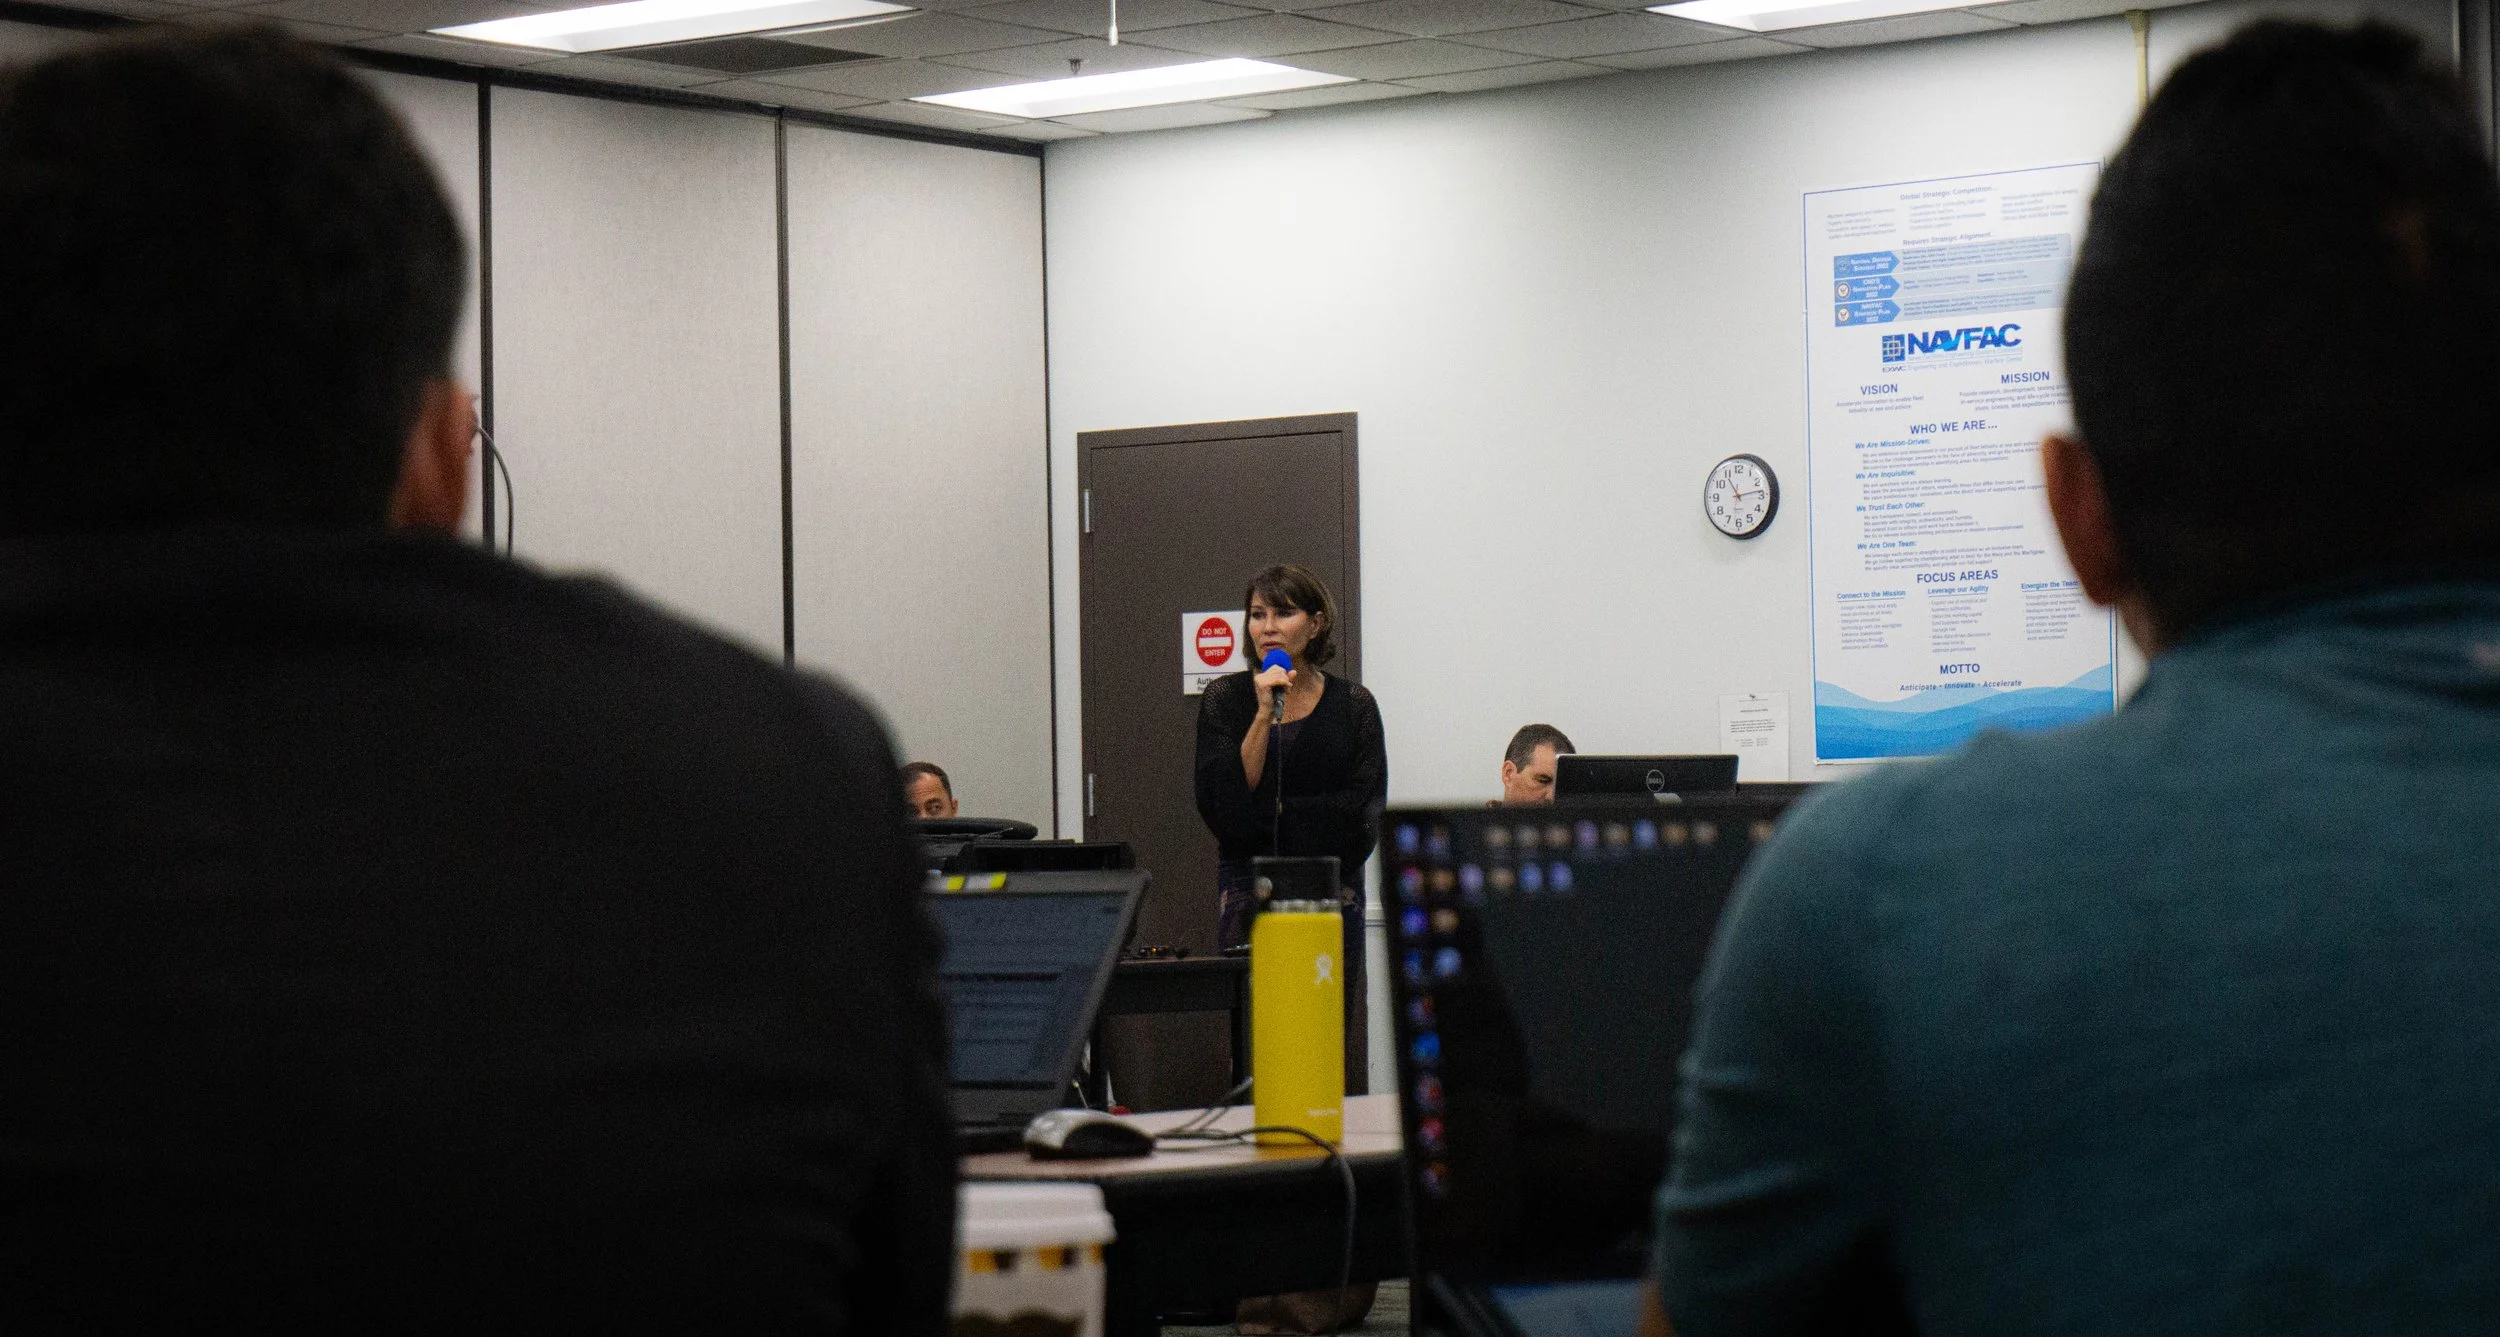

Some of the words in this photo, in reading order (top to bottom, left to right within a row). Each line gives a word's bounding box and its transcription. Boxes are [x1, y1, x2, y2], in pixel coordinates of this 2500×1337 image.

[1922, 190, 1950, 199] Strategic
[1931, 235, 1958, 243] Strategic
[1907, 323, 2022, 355] NAVFAC
[2001, 371, 2050, 384] MISSION
[1860, 383, 1898, 395] VISION
[1910, 423, 1937, 435] WHO
[1940, 421, 1960, 433] WE
[1867, 441, 1878, 449] Are
[1725, 470, 1731, 478] 11
[1735, 465, 1743, 474] 12
[1716, 480, 1726, 489] 10
[1755, 478, 1760, 487] 2
[1712, 493, 1720, 502] 9
[1759, 490, 1765, 500] 3
[1717, 506, 1724, 515] 8
[1754, 504, 1761, 512] 4
[1726, 515, 1732, 524] 7
[1735, 518, 1742, 528] 6
[1746, 514, 1754, 523] 5
[1916, 571, 1956, 584] FOCUS
[1959, 569, 1999, 581] AREAS
[1969, 585, 1989, 593] Agility
[1214, 627, 1227, 635] NOT
[1205, 649, 1225, 657] ENTER
[1940, 663, 1980, 675] MOTTO
[1900, 683, 1937, 692] Anticipate
[1944, 681, 1976, 689] Innovate
[1983, 680, 2022, 688] Accelerate
